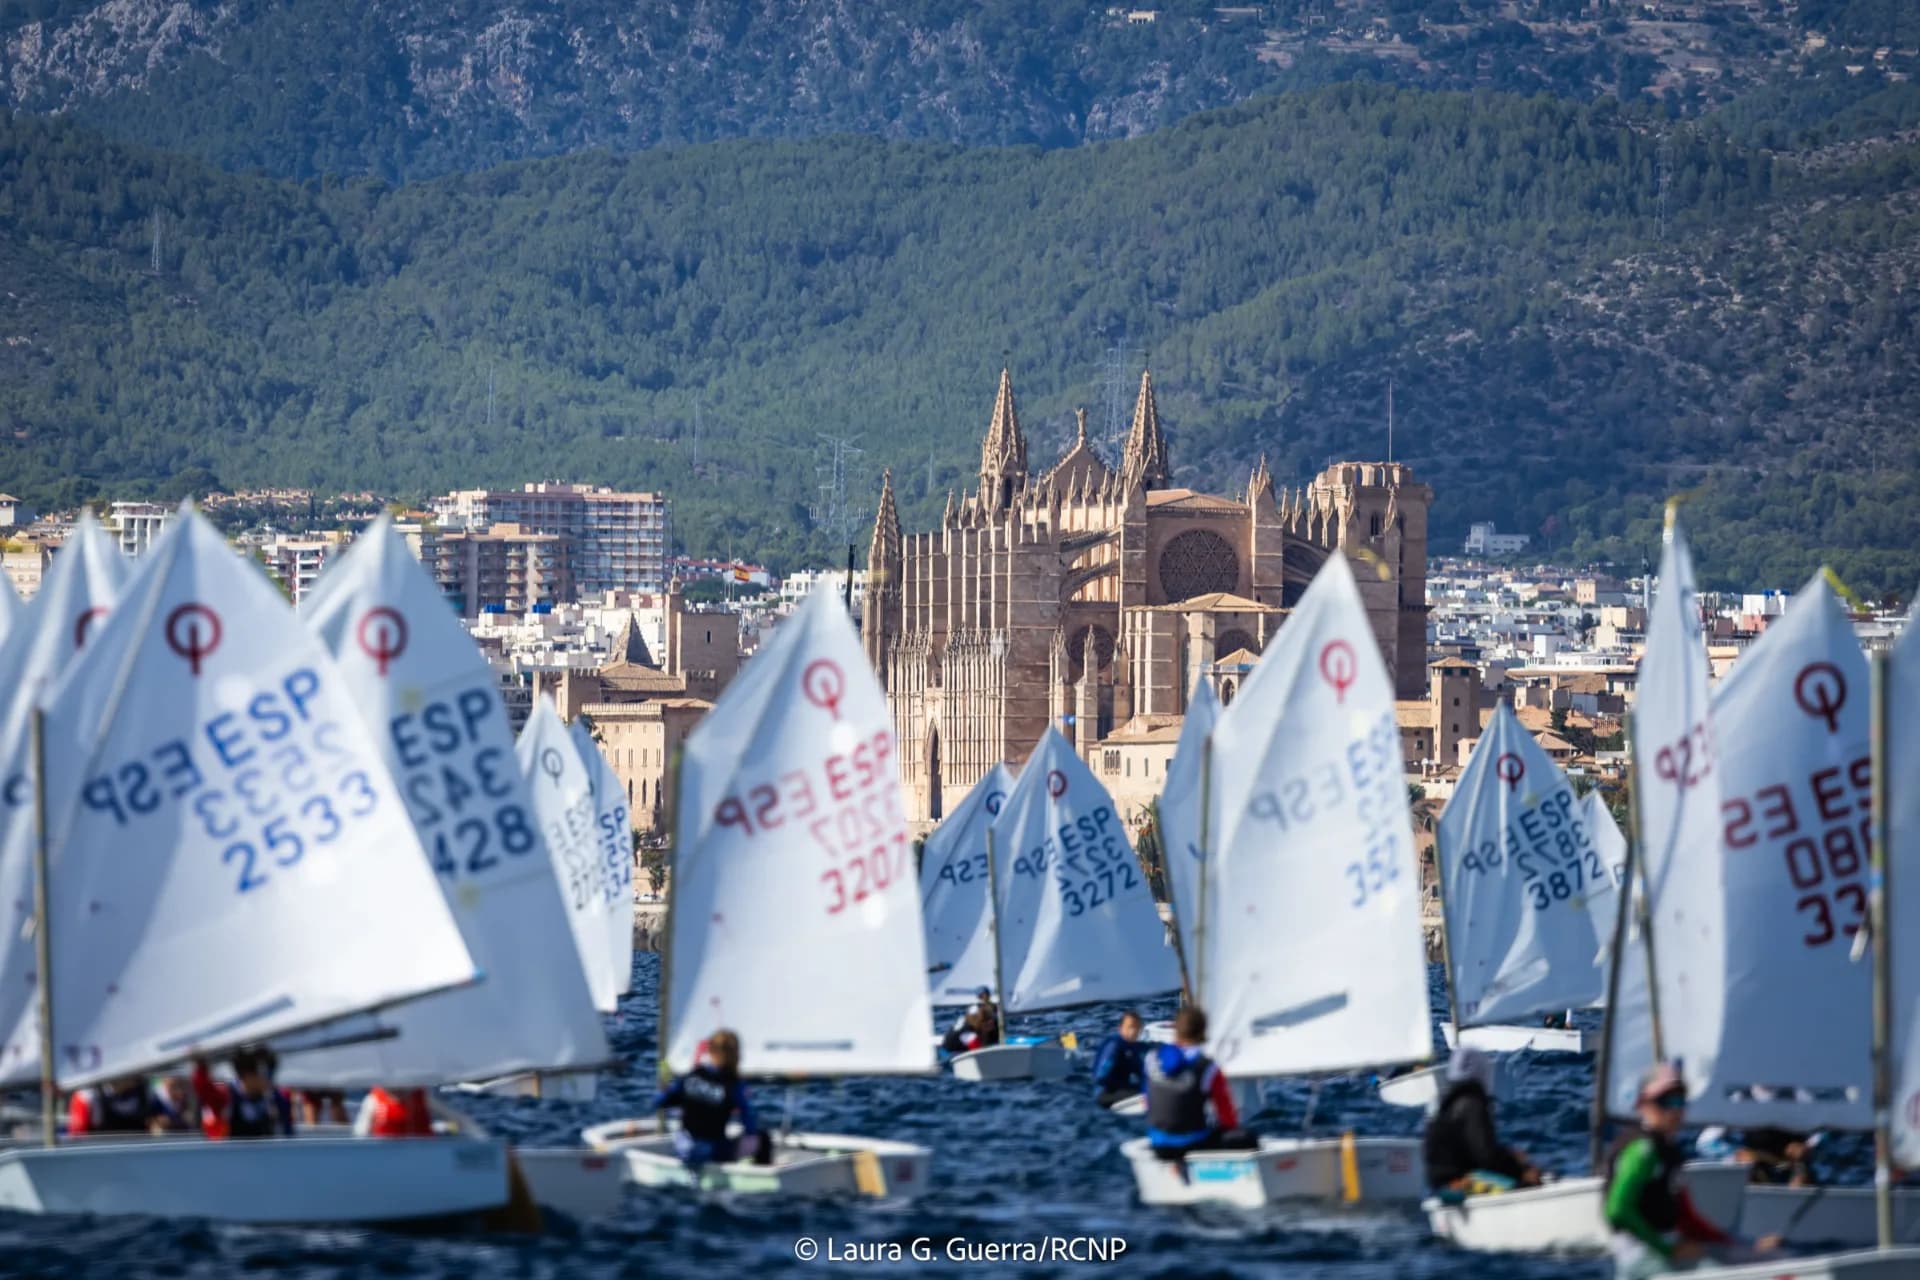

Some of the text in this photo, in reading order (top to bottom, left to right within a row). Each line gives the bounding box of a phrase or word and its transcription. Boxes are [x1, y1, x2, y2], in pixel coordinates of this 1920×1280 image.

[204, 667, 319, 768] ESP
[391, 688, 493, 768] ESP
[824, 729, 891, 800] ESP
[221, 769, 379, 893] 2533
[600, 807, 625, 840] SP
[1058, 805, 1111, 852] ESP
[1518, 789, 1572, 842] ESP
[820, 831, 907, 915] 3207
[1062, 861, 1138, 917] 3272
[1528, 850, 1604, 911] 3872
[1796, 884, 1868, 946] 33
